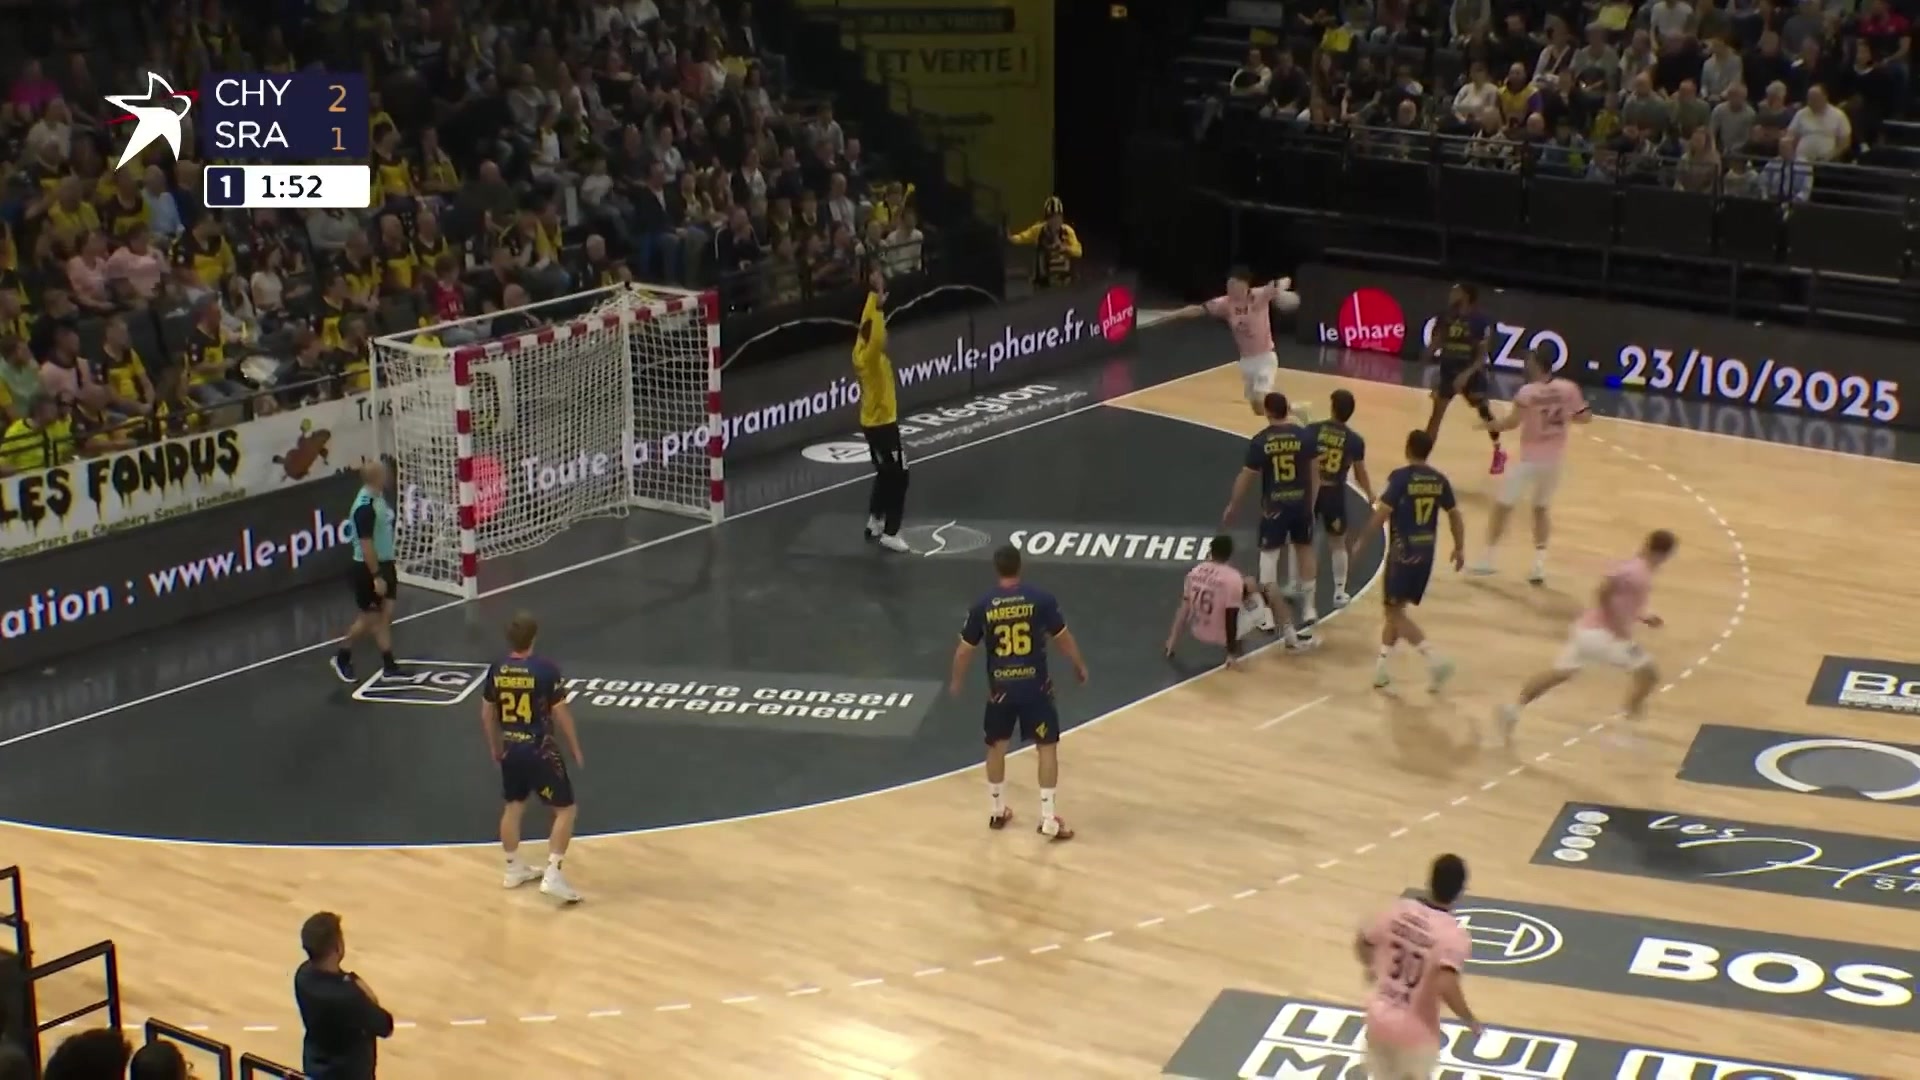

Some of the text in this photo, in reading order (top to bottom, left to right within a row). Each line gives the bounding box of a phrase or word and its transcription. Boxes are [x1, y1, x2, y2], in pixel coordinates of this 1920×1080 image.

[919, 48, 1012, 73] VERTE
[1102, 293, 1134, 339] phare
[1319, 291, 1405, 347] le phare
[662, 374, 862, 466] programmatio
[899, 309, 1084, 388] www.le-phare.fr
[1618, 344, 1900, 422] 23/10/2025
[0, 428, 241, 530] LES FONDUS
[1272, 454, 1298, 483] 15
[1414, 497, 1436, 526] 17
[986, 604, 1035, 623] MARESCOT
[994, 621, 1033, 657] 36
[500, 691, 532, 724] 24
[563, 677, 914, 708] rtenaire conseil
[1628, 936, 1914, 1007] BOS
[1282, 1008, 1561, 1073] LIUI
